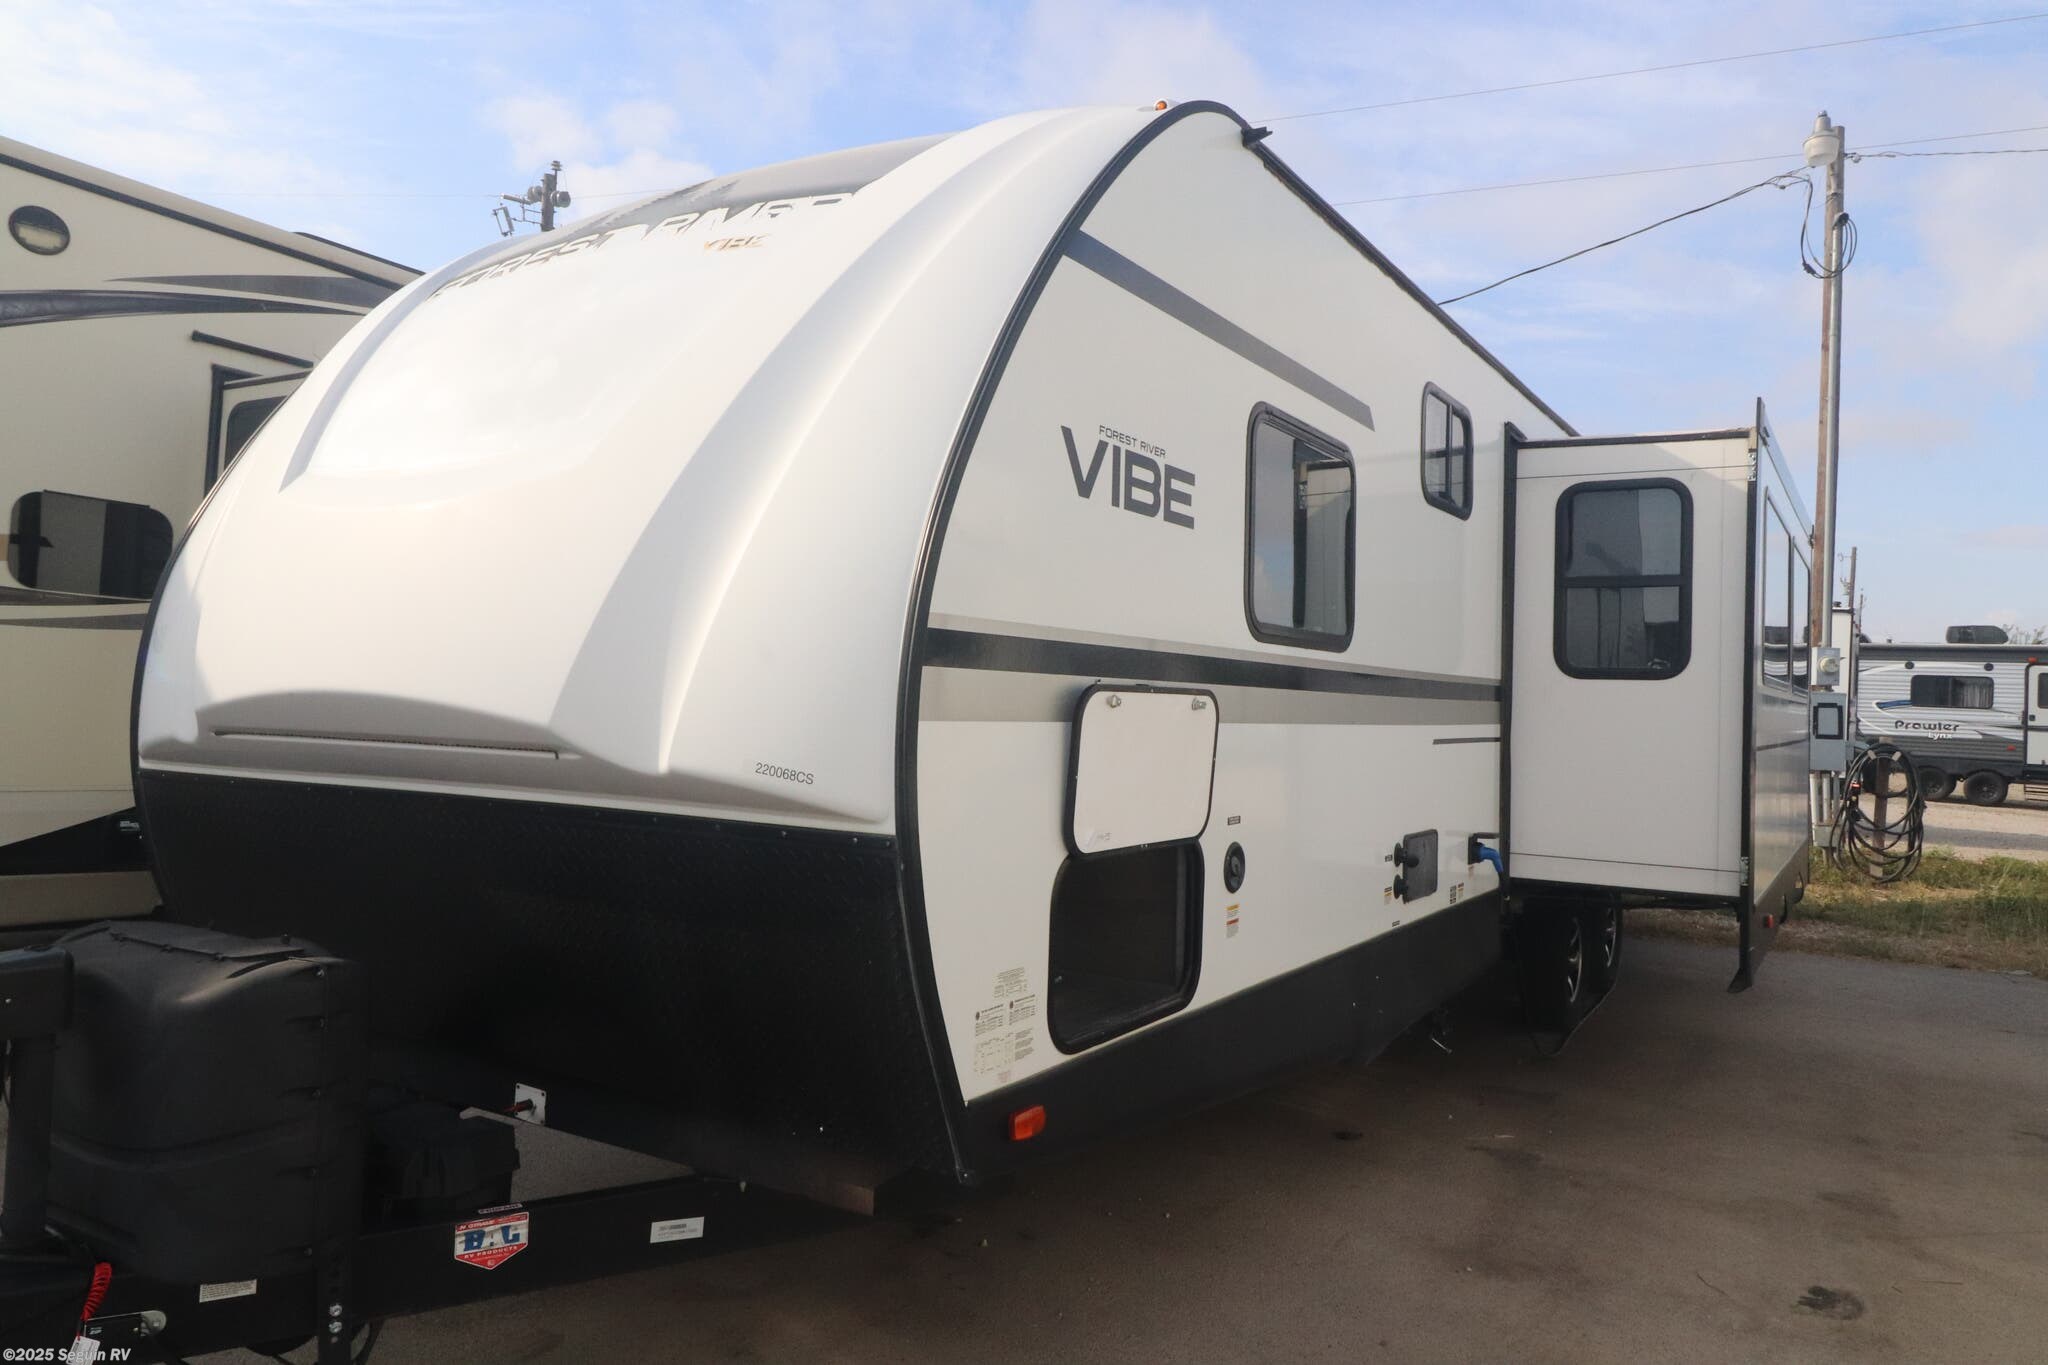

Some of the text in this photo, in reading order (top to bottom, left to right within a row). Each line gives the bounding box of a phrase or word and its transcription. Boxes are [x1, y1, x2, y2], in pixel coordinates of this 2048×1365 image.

[1098, 424, 1167, 459] FOREST RIVER
[1060, 424, 1196, 530] VIBE
[1895, 720, 1960, 731] Prowler
[1928, 732, 1953, 741] Lynx
[755, 762, 814, 785] 220068CS
